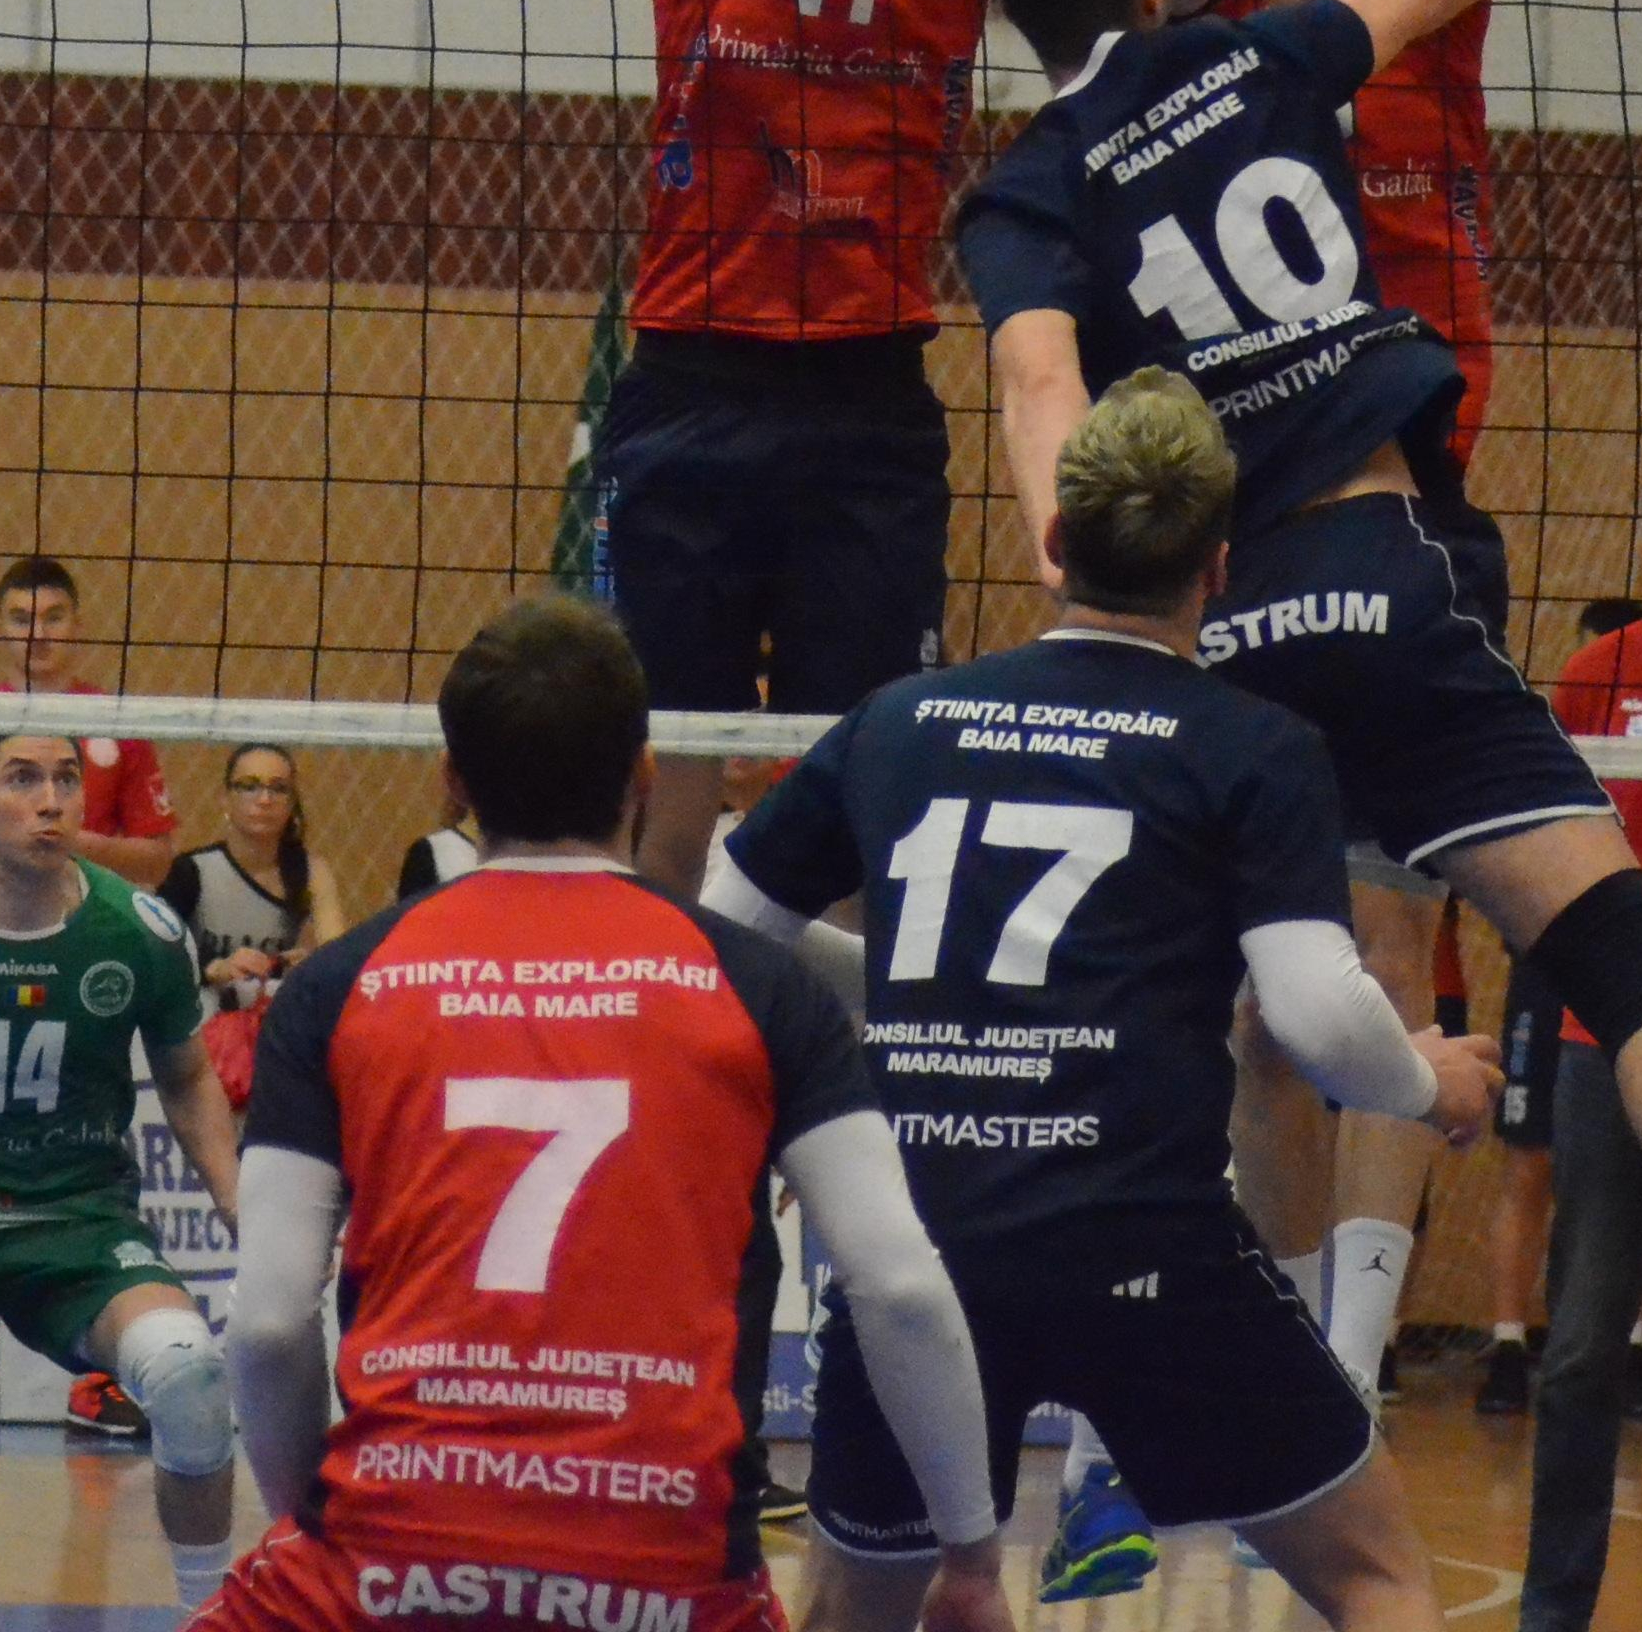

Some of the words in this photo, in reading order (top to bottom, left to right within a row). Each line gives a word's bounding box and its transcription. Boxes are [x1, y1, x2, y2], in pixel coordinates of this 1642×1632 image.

[1111, 139, 1175, 186] BAIA
[1169, 91, 1246, 148] MARE
[1127, 155, 1360, 342] 10
[1187, 318, 1313, 372] CONSILIUL
[1197, 590, 1390, 667] STRUM
[914, 699, 1017, 727] ȘTIINȚA
[1021, 703, 1179, 738] EXPLORĂRI
[957, 728, 1021, 752] BAIA
[1027, 733, 1109, 760] MARE
[887, 797, 1135, 988] 17
[360, 958, 505, 1000] ȘTIINȚA
[513, 955, 720, 993] EXPLORĂRI
[440, 991, 525, 1019] BAIA
[534, 991, 639, 1019] MARE
[863, 1022, 970, 1047] ONSILIUL
[974, 1026, 1117, 1055] JUDEȚEAN
[886, 1051, 1054, 1085] MARAMUREȘ
[443, 1076, 632, 1294] 7
[360, 1342, 520, 1377] CONSILIUL
[527, 1346, 697, 1388] JUDEȚEAN
[416, 1376, 629, 1422] MARAMUREȘ
[353, 1443, 698, 1508] PRINTMASTERS
[357, 1562, 693, 1632] CASTRUM
